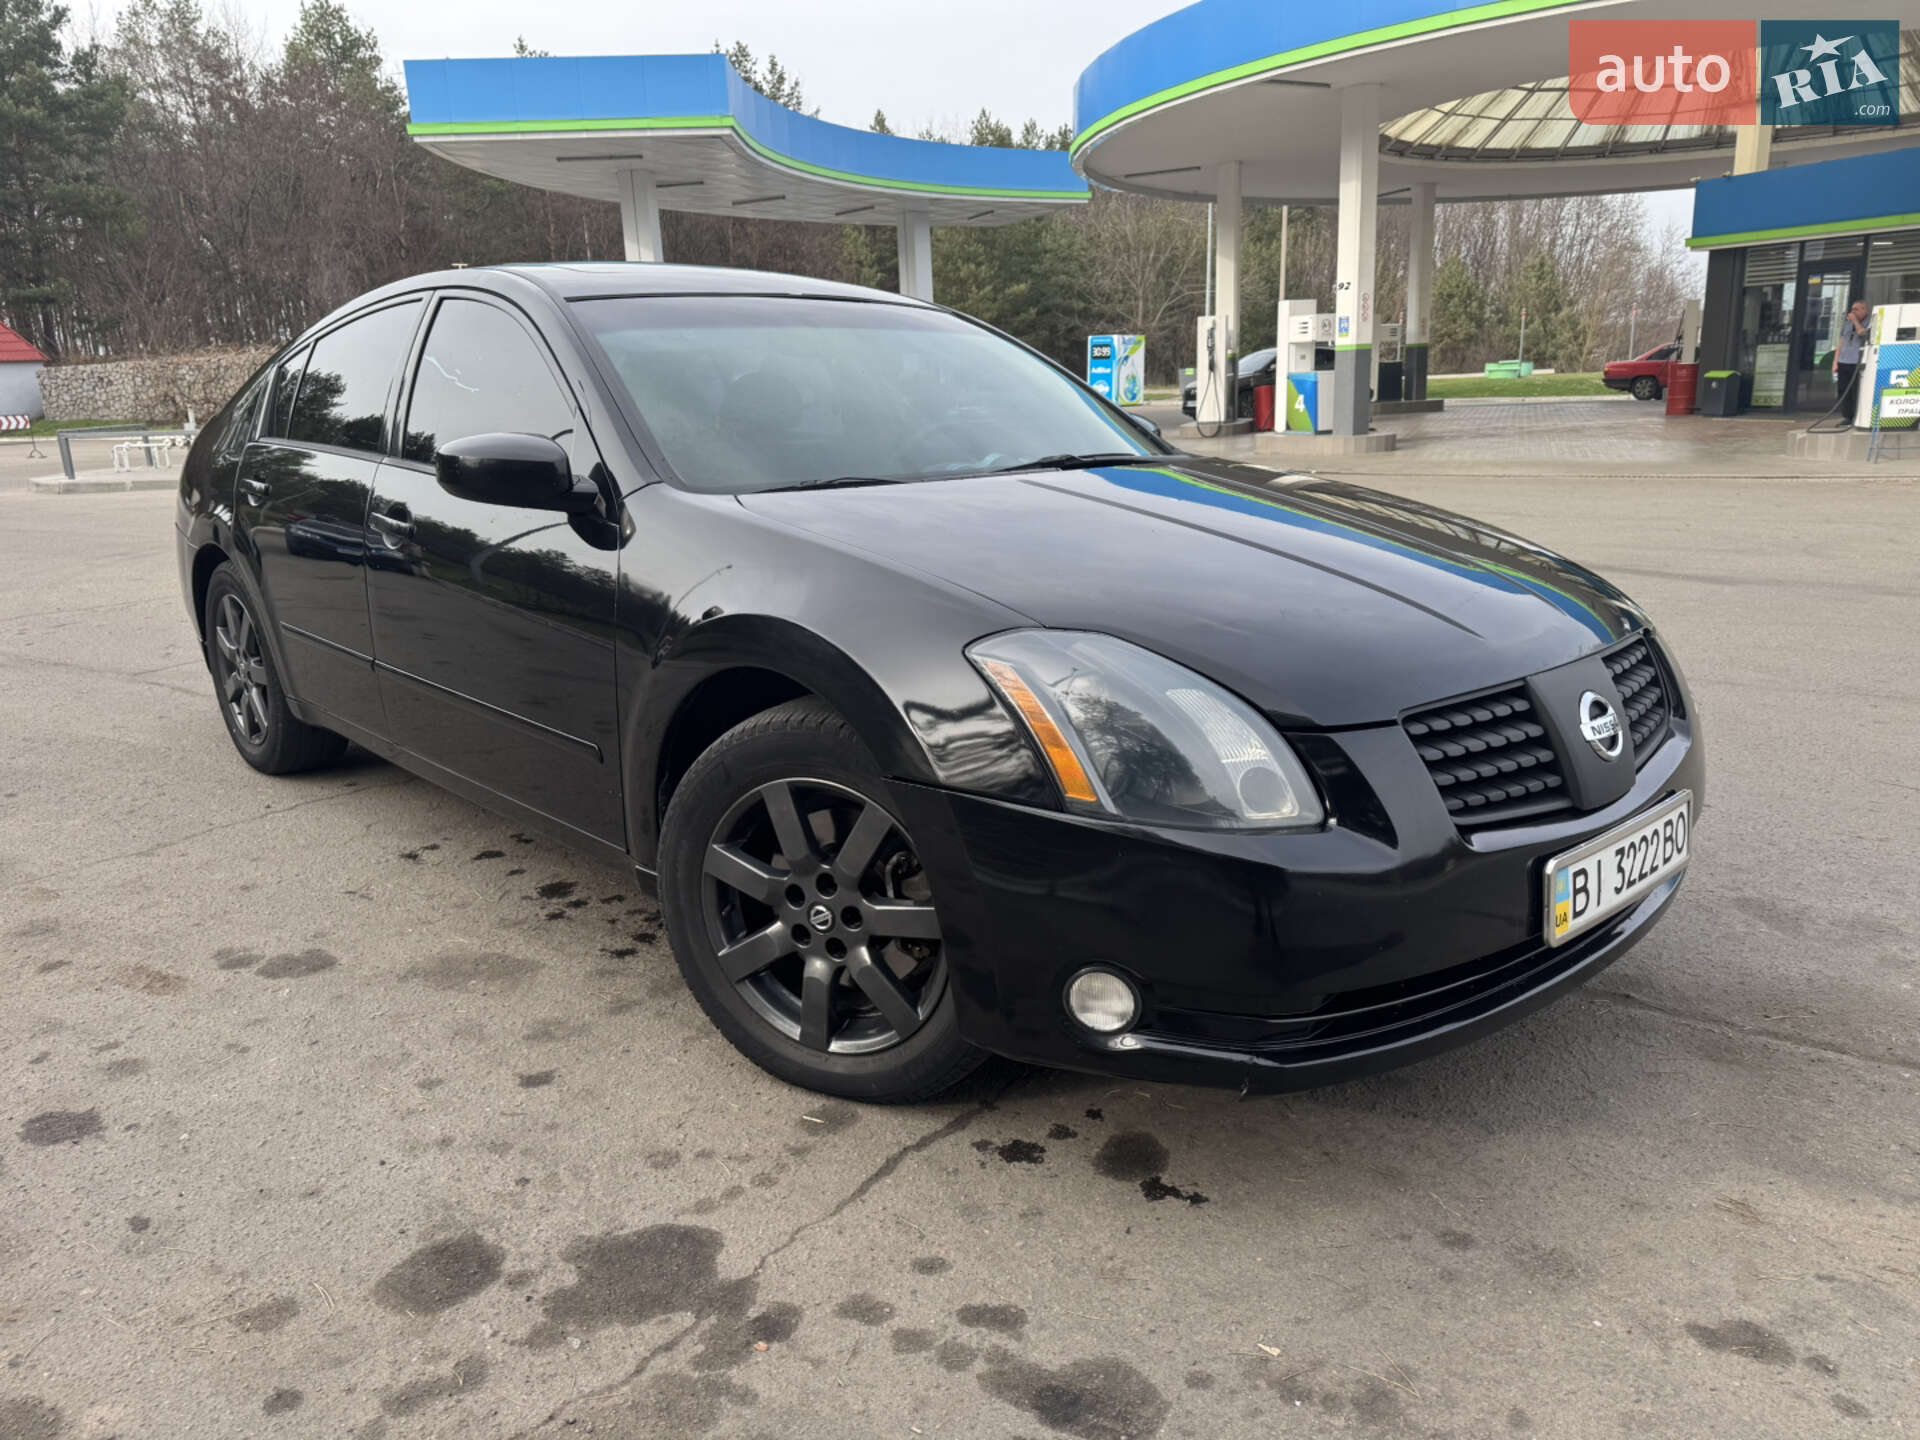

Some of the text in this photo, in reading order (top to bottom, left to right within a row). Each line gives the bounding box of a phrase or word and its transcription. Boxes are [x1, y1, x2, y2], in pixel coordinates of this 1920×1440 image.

[1338, 281, 1351, 290] 92
[1294, 394, 1305, 413] 4
[1572, 859, 1602, 920] BI
[1614, 828, 1660, 895] 3222
[1555, 911, 1568, 928] UA
